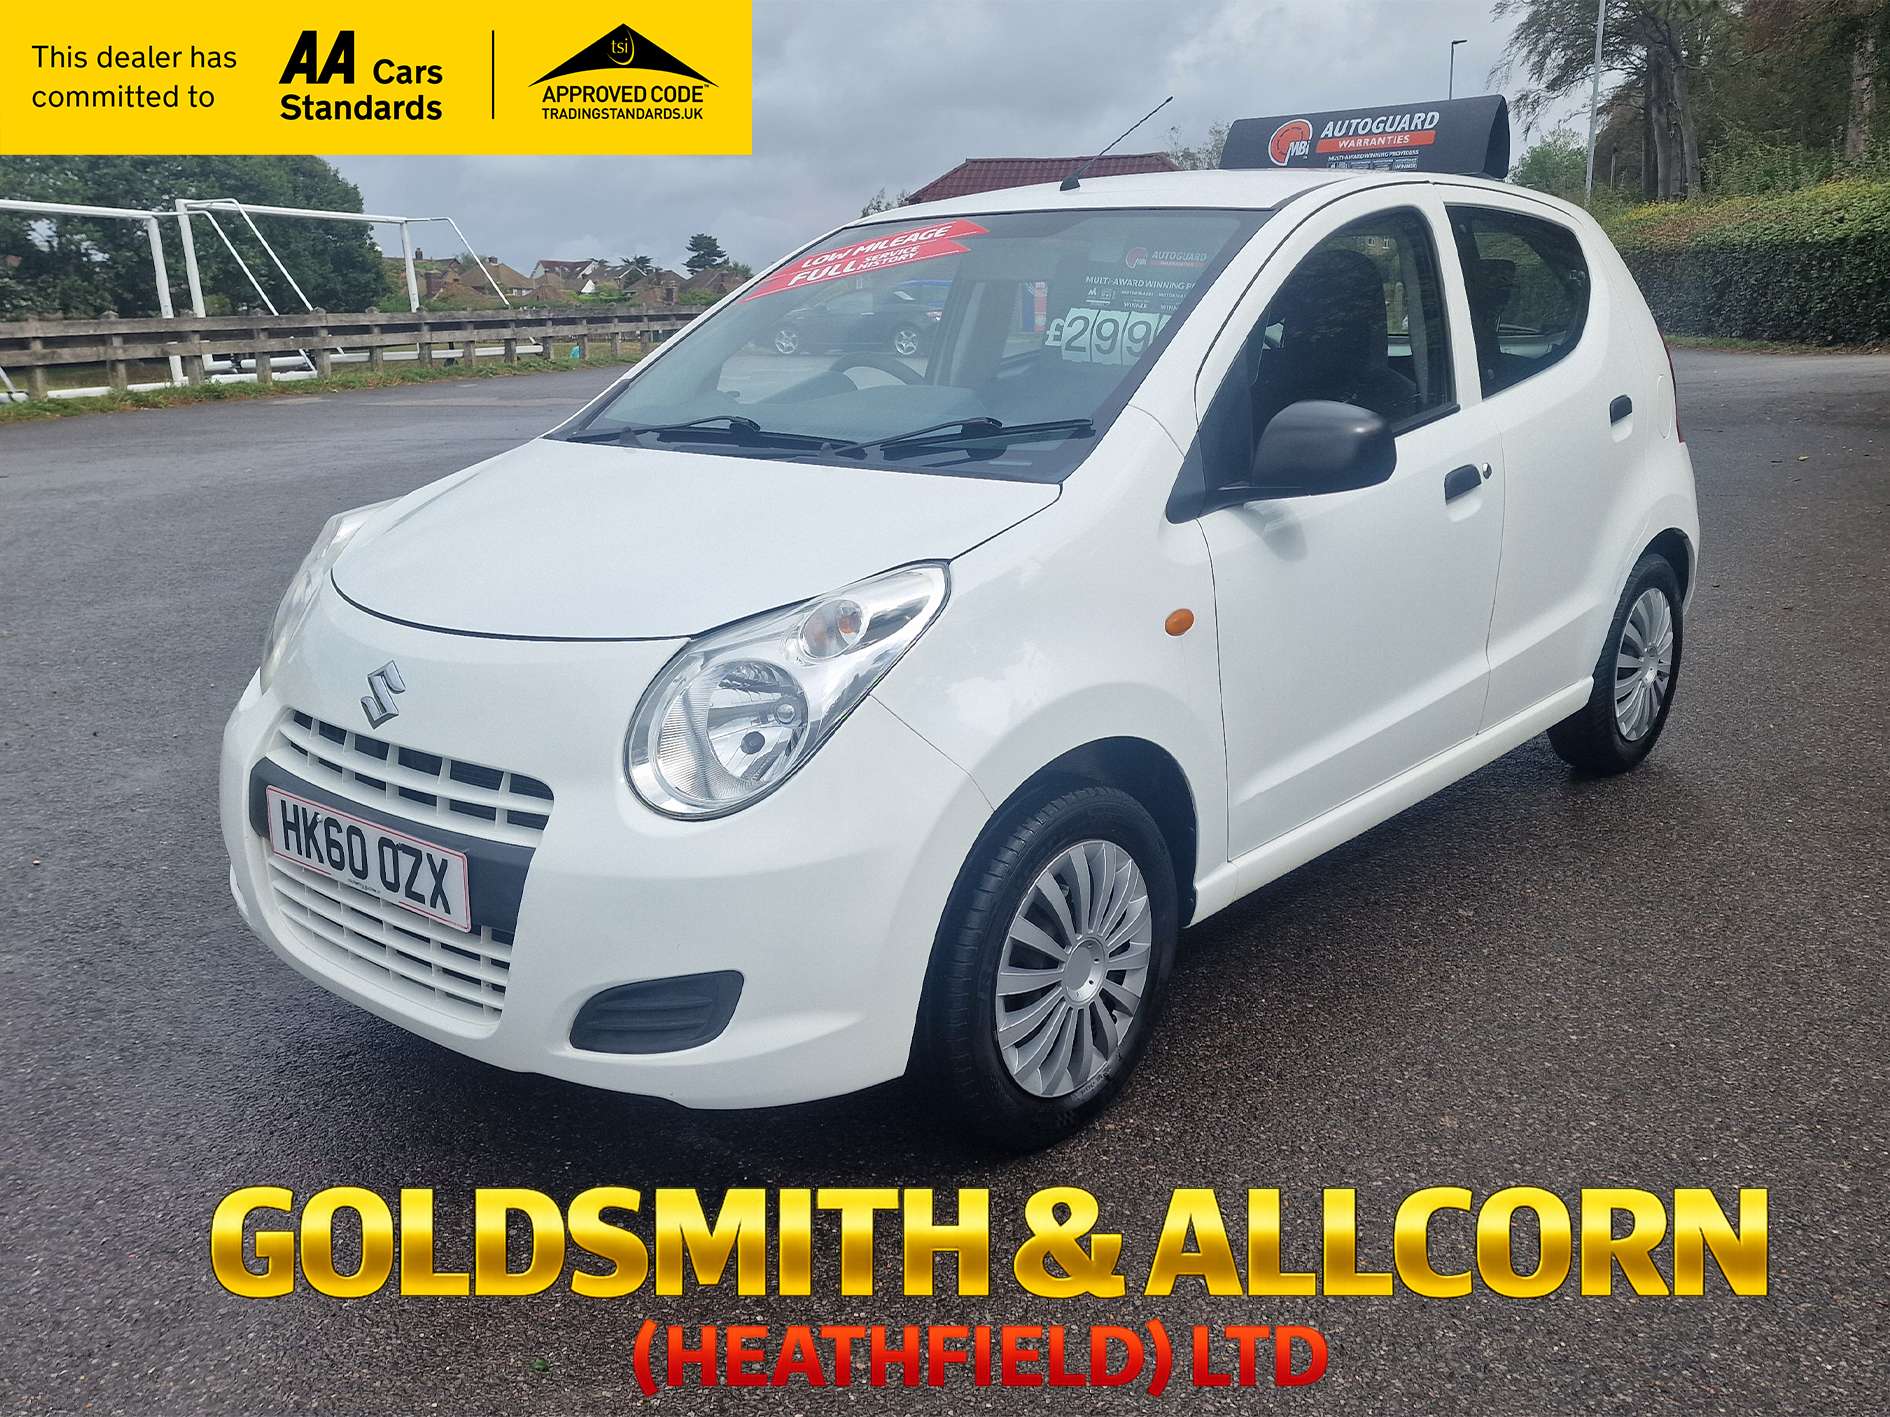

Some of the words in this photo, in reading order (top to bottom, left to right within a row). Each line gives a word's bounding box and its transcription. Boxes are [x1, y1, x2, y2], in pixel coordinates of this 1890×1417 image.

[1320, 111, 1440, 139] AUTOGUARD
[1338, 134, 1411, 149] WARRANTIES
[801, 250, 852, 269] LOW
[853, 225, 952, 256] MILEAGE
[863, 245, 920, 264] SERVICE
[1151, 250, 1208, 262] AUTOGUARD
[856, 251, 919, 271] HISTORY
[787, 259, 857, 287] FULL
[1144, 279, 1186, 291] WINNING
[280, 799, 369, 881] HK60
[377, 836, 452, 915] OZX
